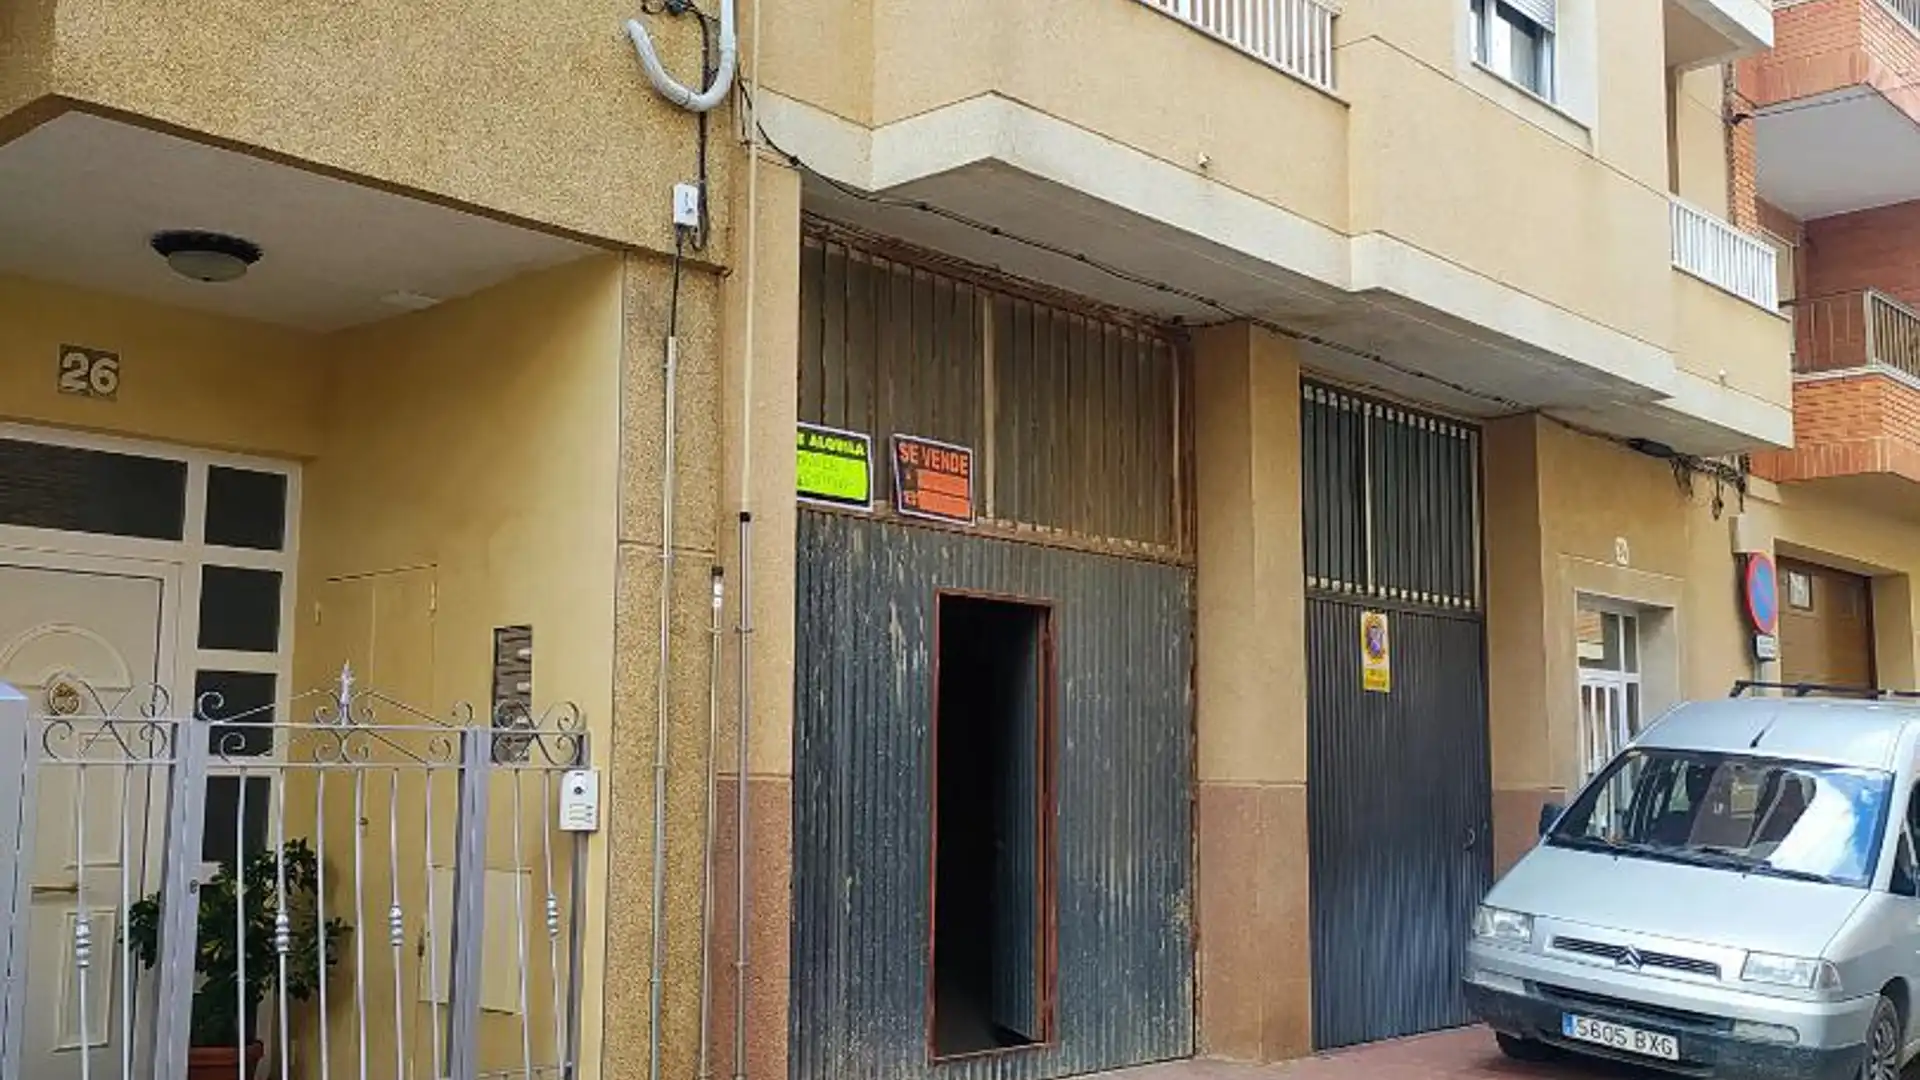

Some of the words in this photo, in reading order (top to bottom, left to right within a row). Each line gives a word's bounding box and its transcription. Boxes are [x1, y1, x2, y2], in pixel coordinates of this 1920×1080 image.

[62, 352, 117, 394] 26
[899, 442, 919, 465] SE
[921, 446, 969, 475] VENDE
